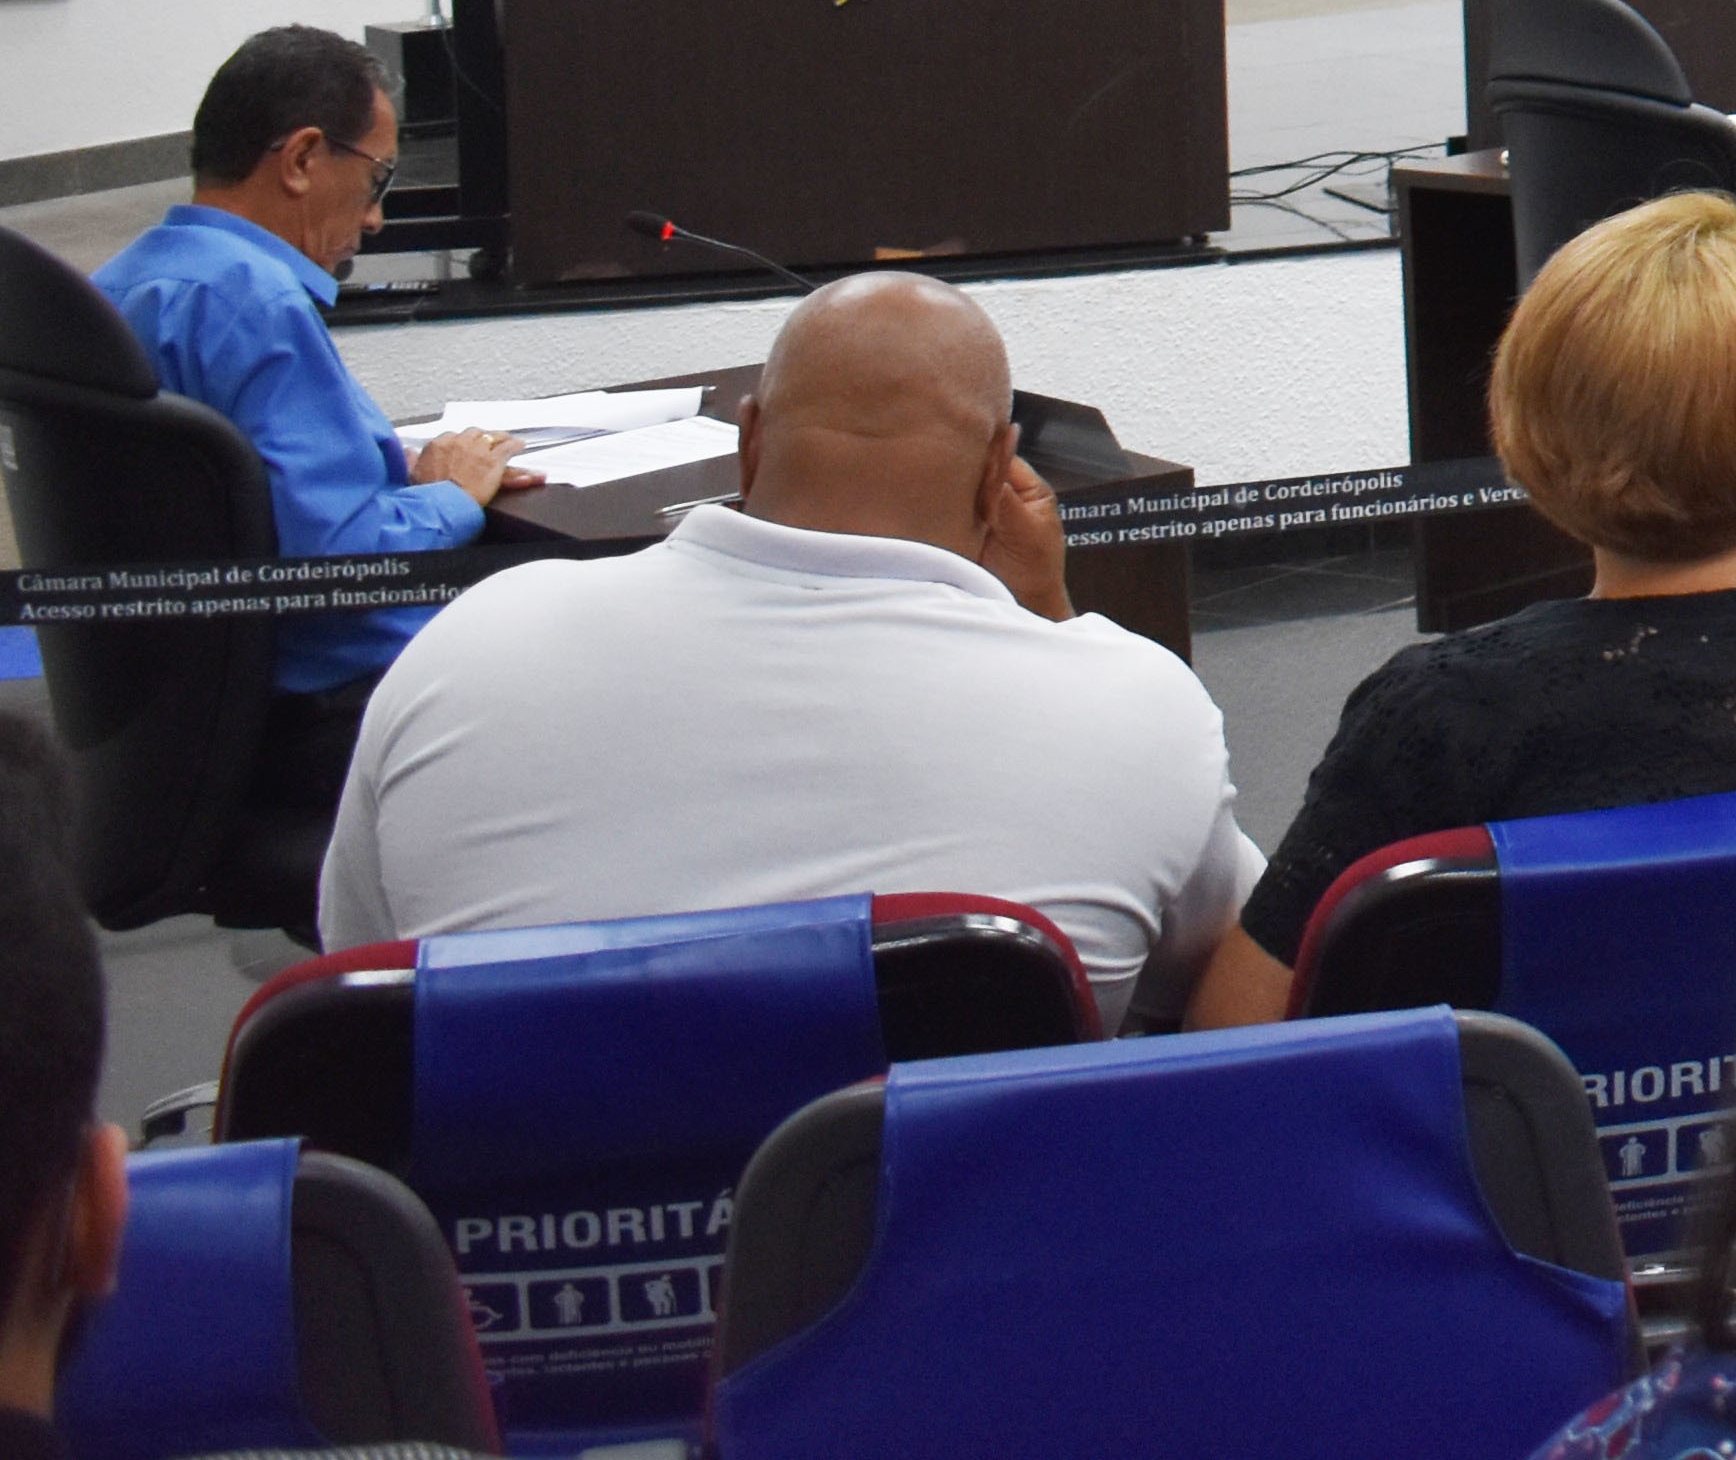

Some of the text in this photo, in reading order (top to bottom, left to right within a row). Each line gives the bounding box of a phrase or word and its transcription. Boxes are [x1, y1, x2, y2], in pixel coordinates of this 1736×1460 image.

[1058, 471, 1404, 520] âmara Municipal de Cordeirópolis
[1062, 485, 1530, 547] esso restrito apenas para funcionários e Vere
[18, 558, 410, 592] Câmara Municipal de Cordeirópolis
[20, 583, 470, 620] Acesso restrito apenas para funcionário
[455, 1188, 736, 1255] PRIORITÁ
